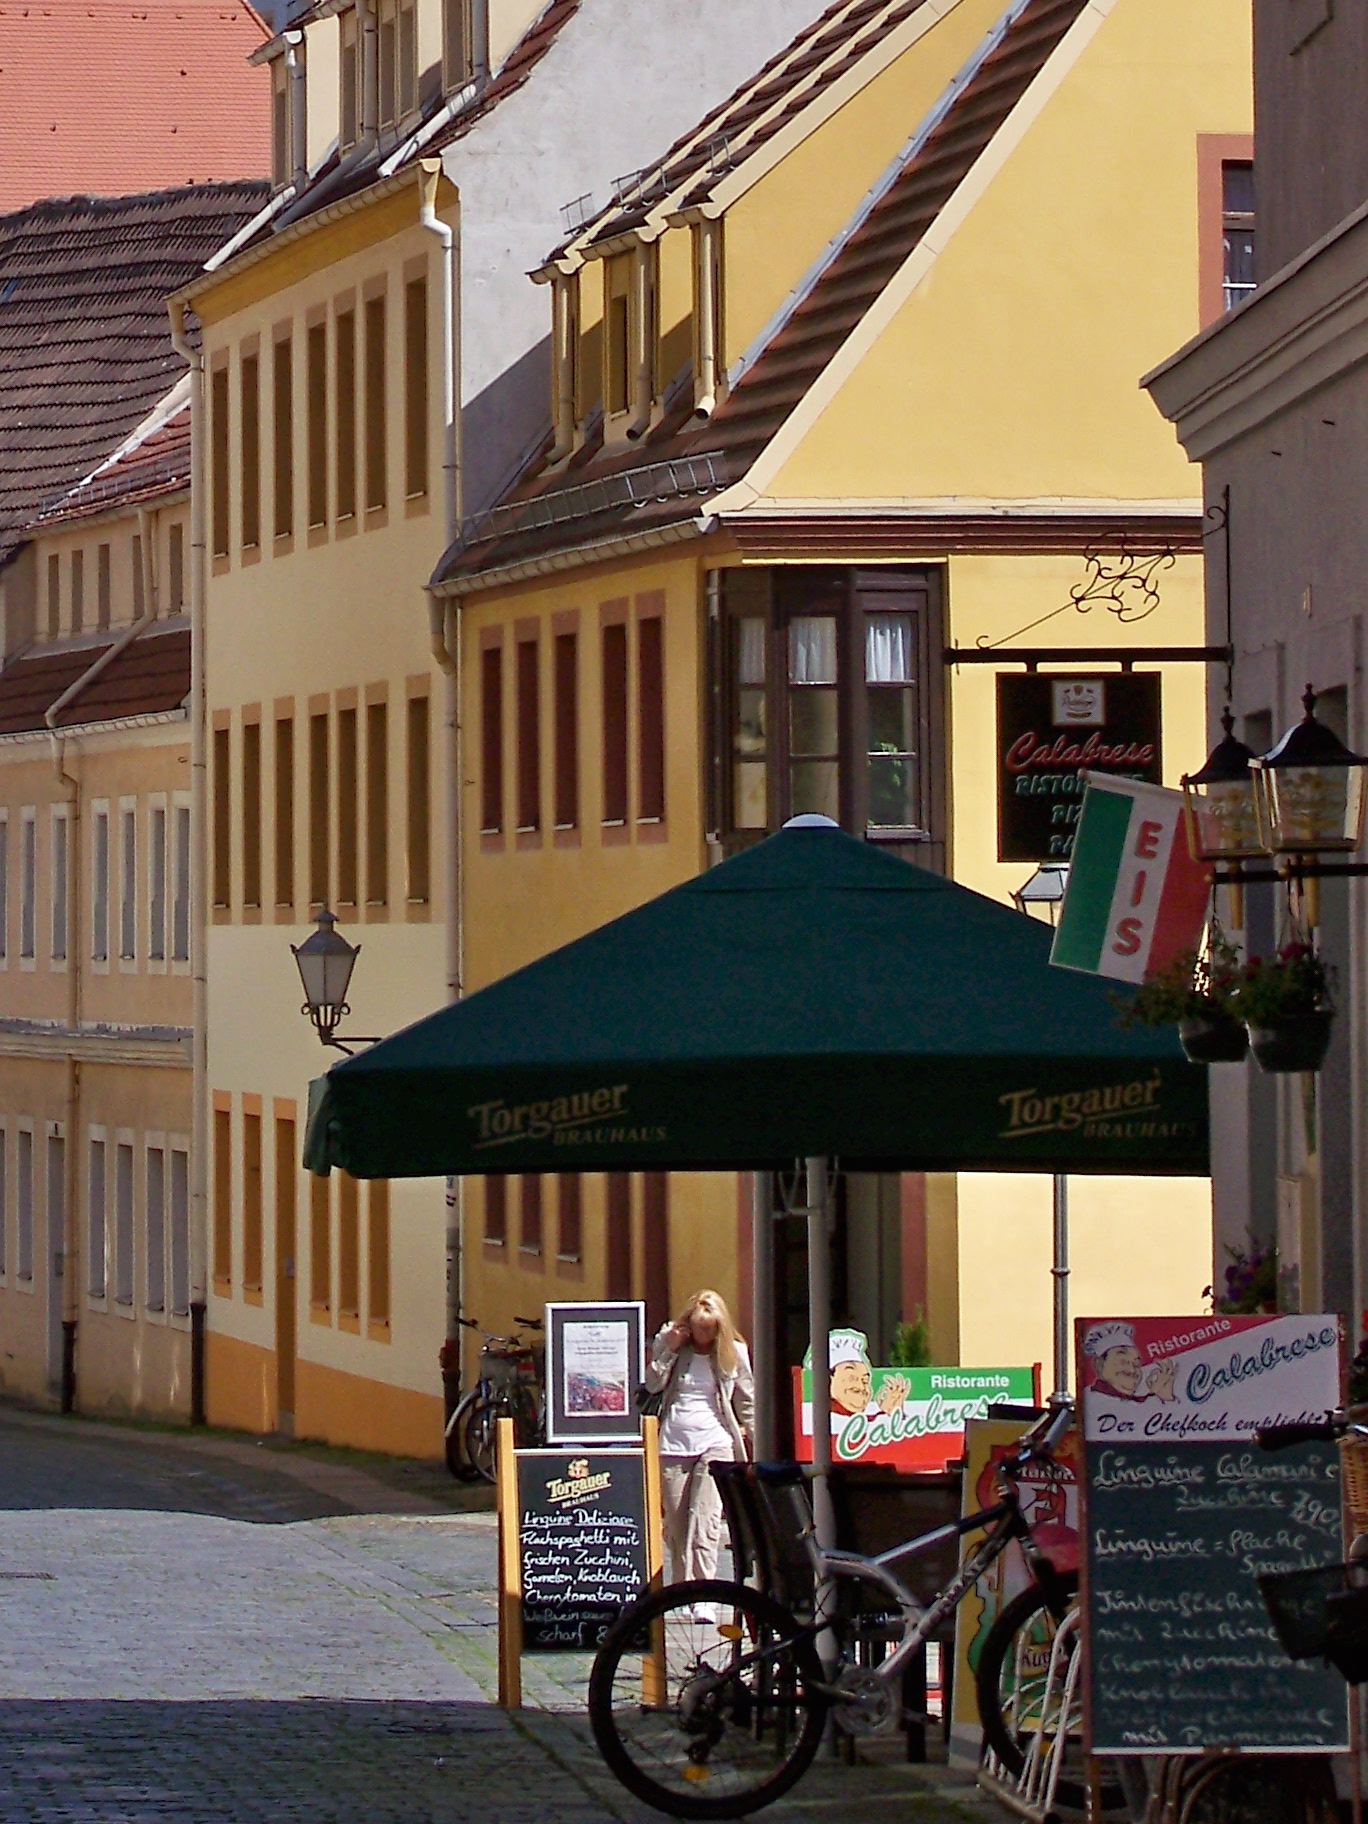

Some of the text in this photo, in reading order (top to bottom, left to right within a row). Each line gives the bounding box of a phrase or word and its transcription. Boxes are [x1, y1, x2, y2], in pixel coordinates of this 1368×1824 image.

[1006, 731, 1155, 773] Calabrese
[1111, 819, 1163, 956] EIS
[467, 1084, 629, 1140] Torgauer
[998, 1078, 1162, 1132] Torgauer
[552, 1126, 668, 1146] BRAUHAUS
[1146, 1318, 1232, 1358] Ristorante
[1187, 1325, 1337, 1404] Calabrese
[931, 1373, 1010, 1389] Ristorante
[1097, 1413, 1135, 1434] Der
[1144, 1410, 1228, 1439] Chefkoch
[546, 1472, 612, 1499] Torgauer
[523, 1510, 573, 1528] Linguine
[519, 1528, 640, 1550] Flachspaghetti mit
[522, 1550, 570, 1569] frischen
